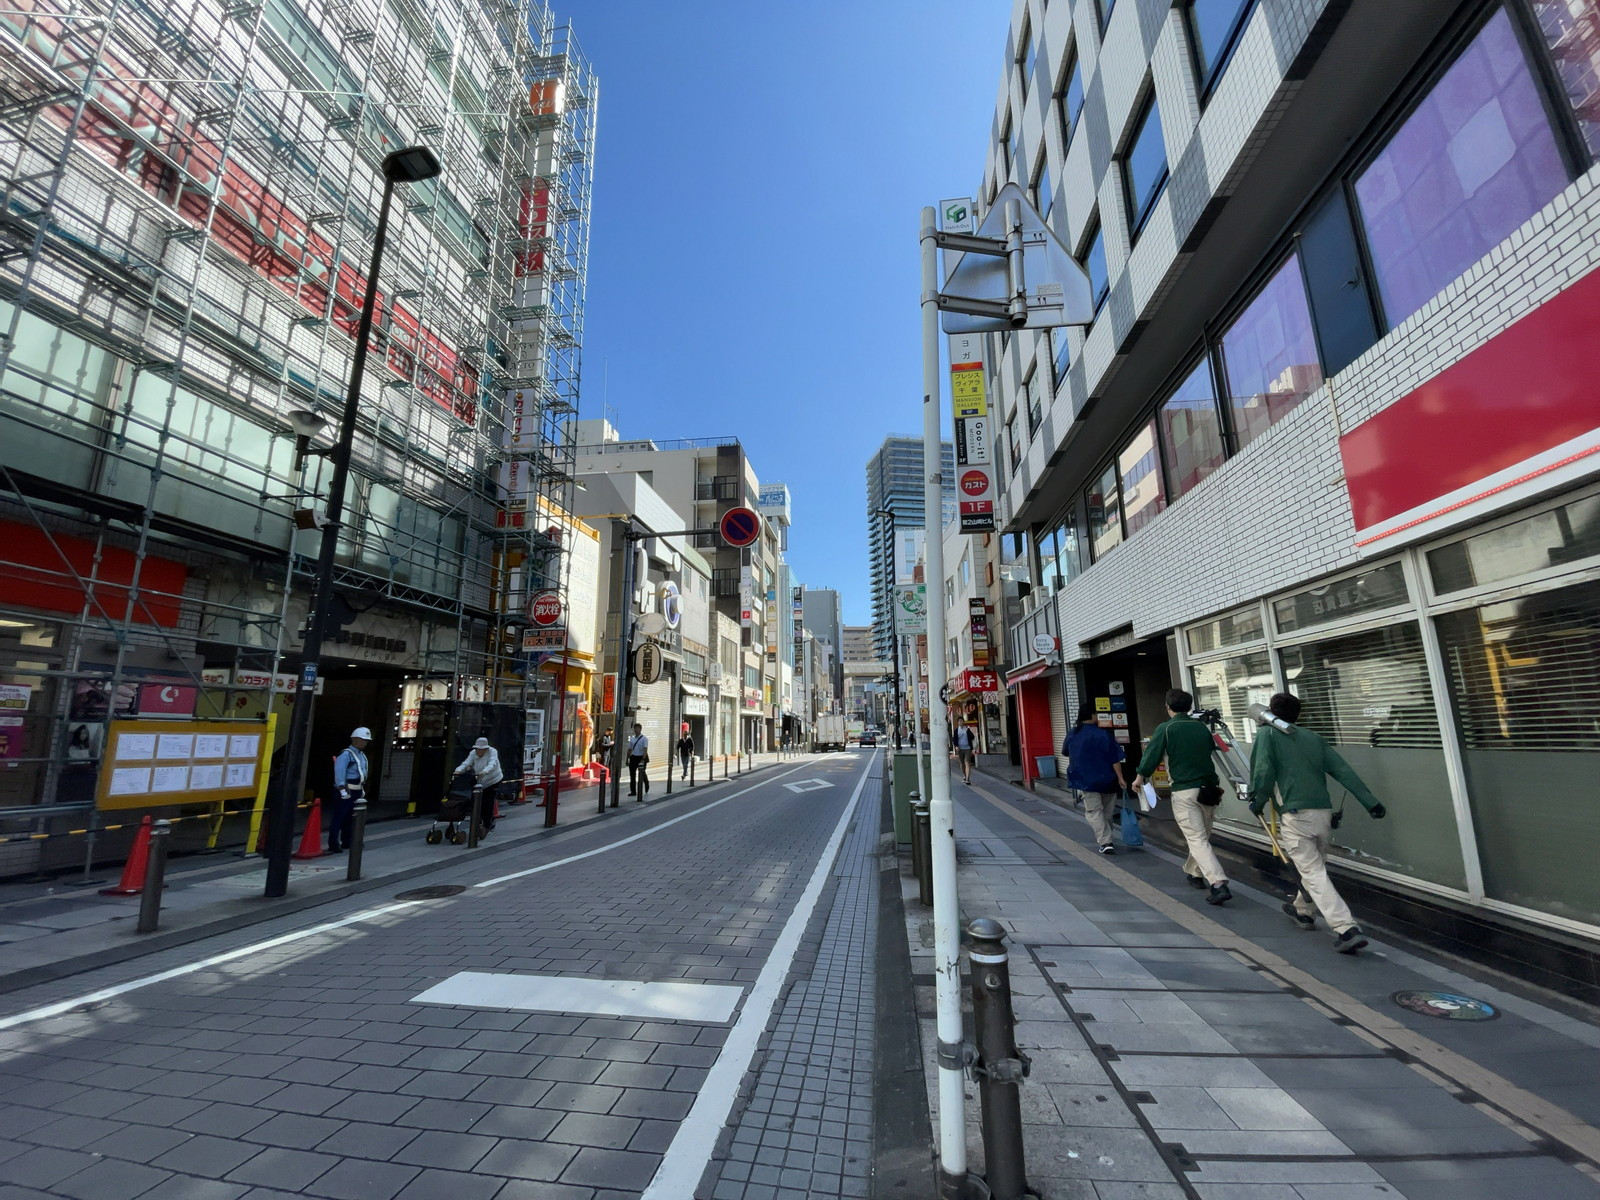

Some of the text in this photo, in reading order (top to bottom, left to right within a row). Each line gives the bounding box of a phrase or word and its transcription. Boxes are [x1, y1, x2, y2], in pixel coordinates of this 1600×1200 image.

[962, 340, 971, 360] ヨガ
[955, 372, 980, 380] プレシス
[975, 422, 986, 459] Goo-it!
[964, 481, 987, 489] ガスト
[968, 502, 986, 512] 1F
[535, 603, 560, 616] 消火栓
[244, 676, 272, 686] カラオ
[969, 674, 996, 689] 餃子
